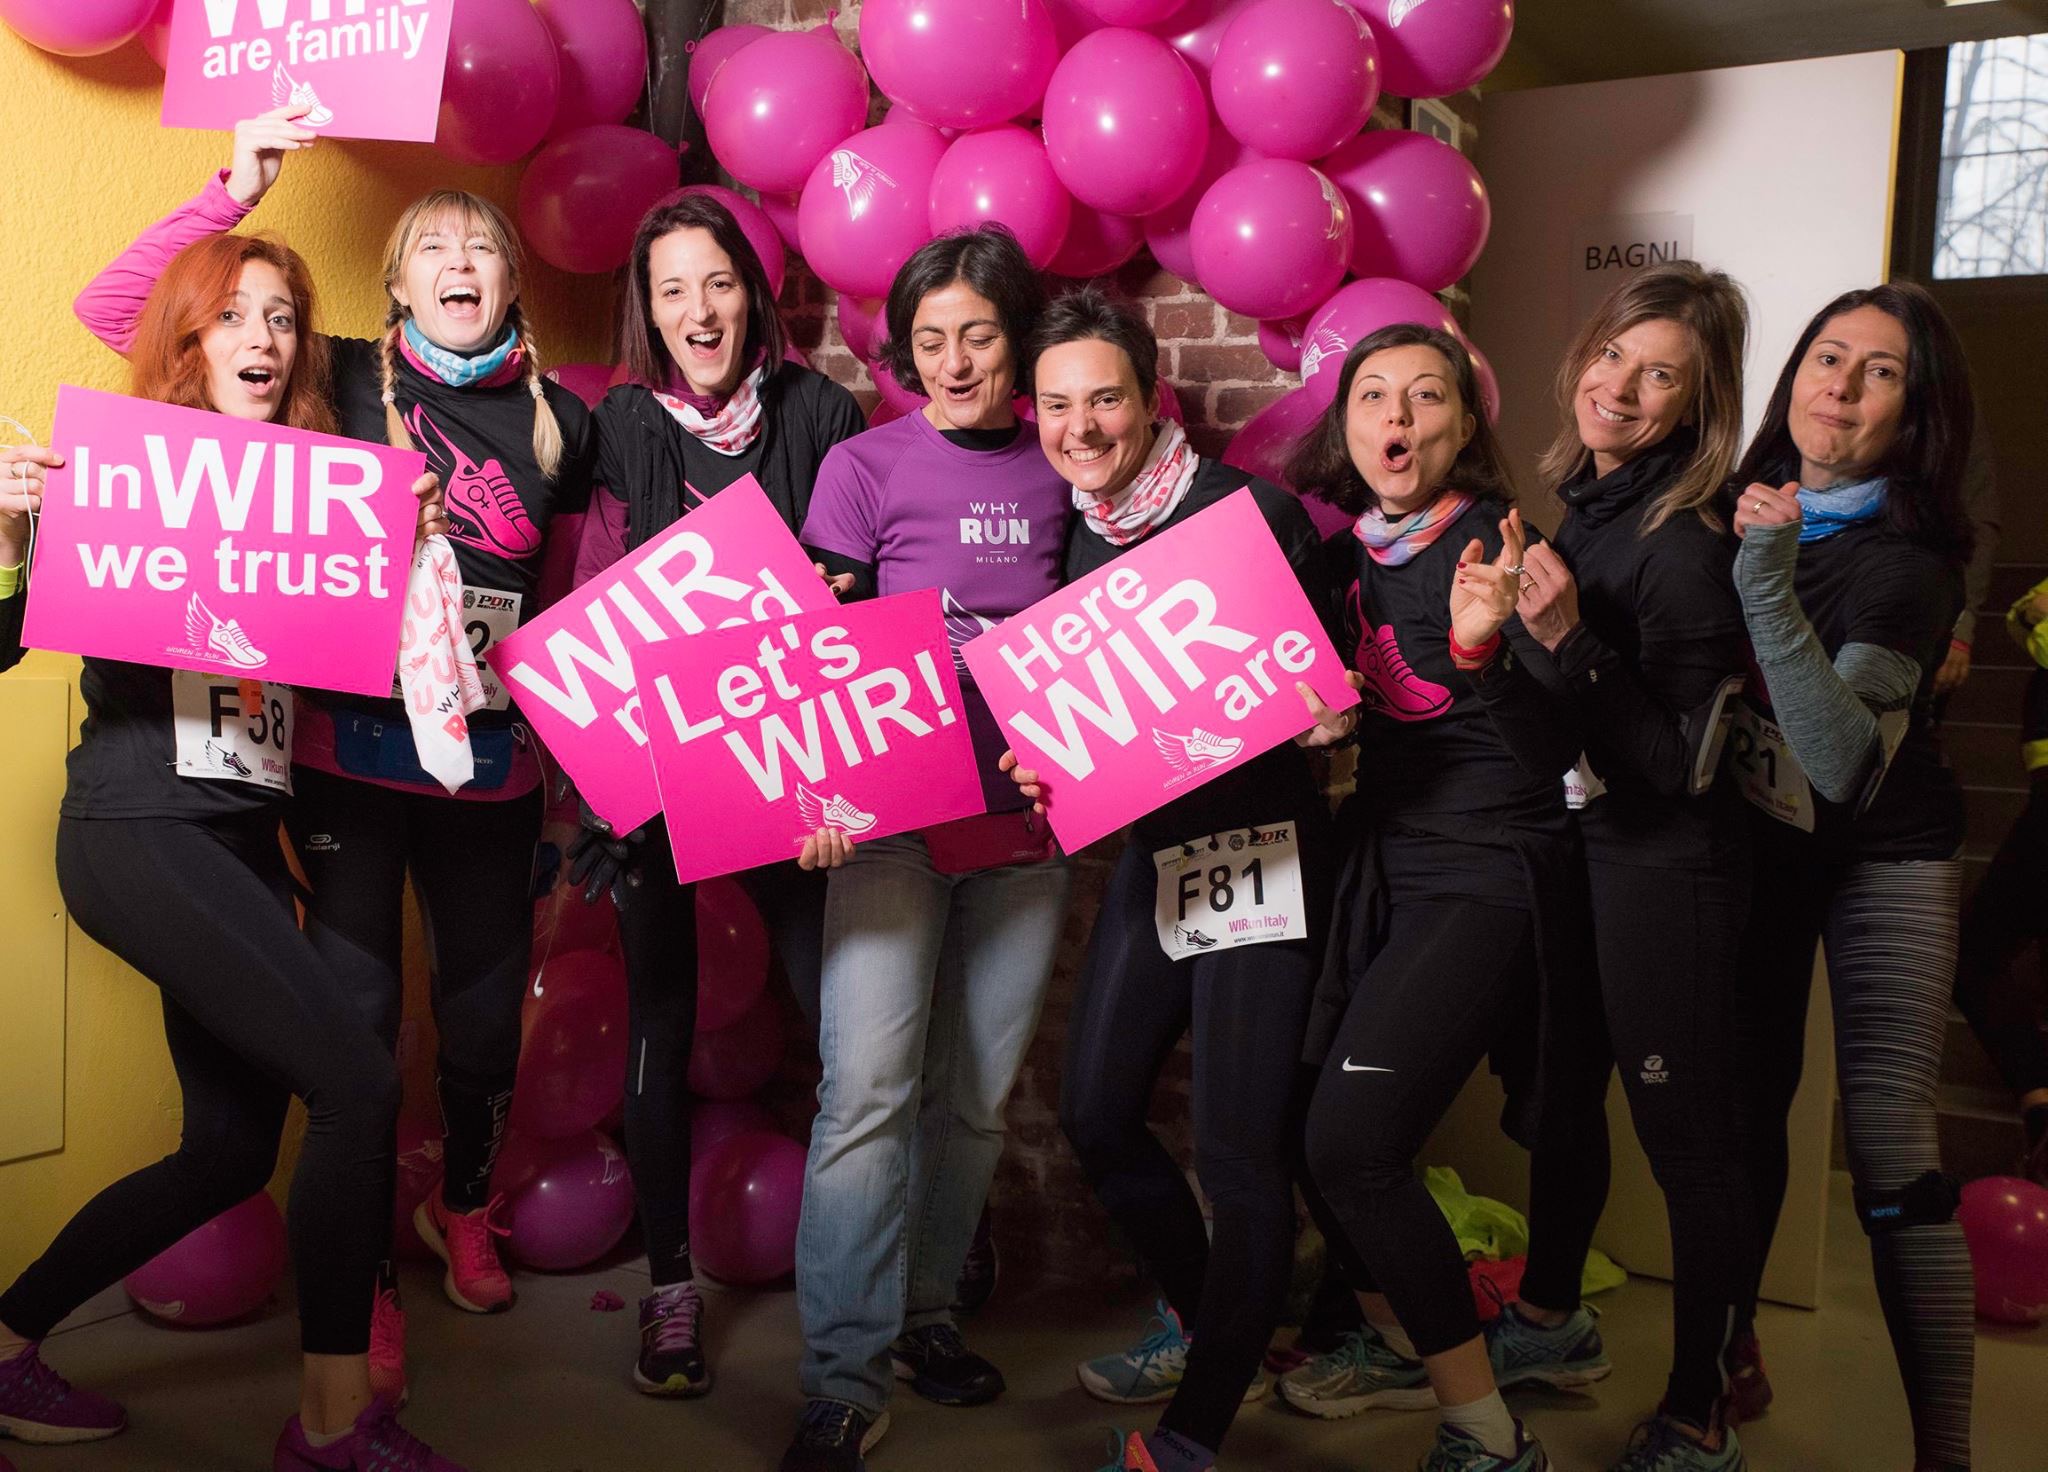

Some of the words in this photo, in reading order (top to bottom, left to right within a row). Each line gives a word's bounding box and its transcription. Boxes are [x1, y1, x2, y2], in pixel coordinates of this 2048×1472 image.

[202, 38, 272, 79] are
[285, 5, 430, 60] family
[1586, 240, 1677, 270] BAGNI
[960, 518, 1030, 544] RUN
[970, 502, 1018, 514] WHY
[77, 543, 187, 590] we
[214, 538, 389, 599] trust
[507, 530, 754, 729] WIR
[998, 567, 1148, 693] Here
[653, 623, 861, 745] Let's
[1007, 579, 1259, 782] WIR
[1215, 630, 1316, 721] are
[208, 686, 285, 751] F58
[722, 650, 957, 803] WIR!
[1248, 829, 1289, 844] DR
[1178, 858, 1265, 921] F81
[1228, 917, 1263, 933] WIRun
[1264, 914, 1288, 930] Italy
